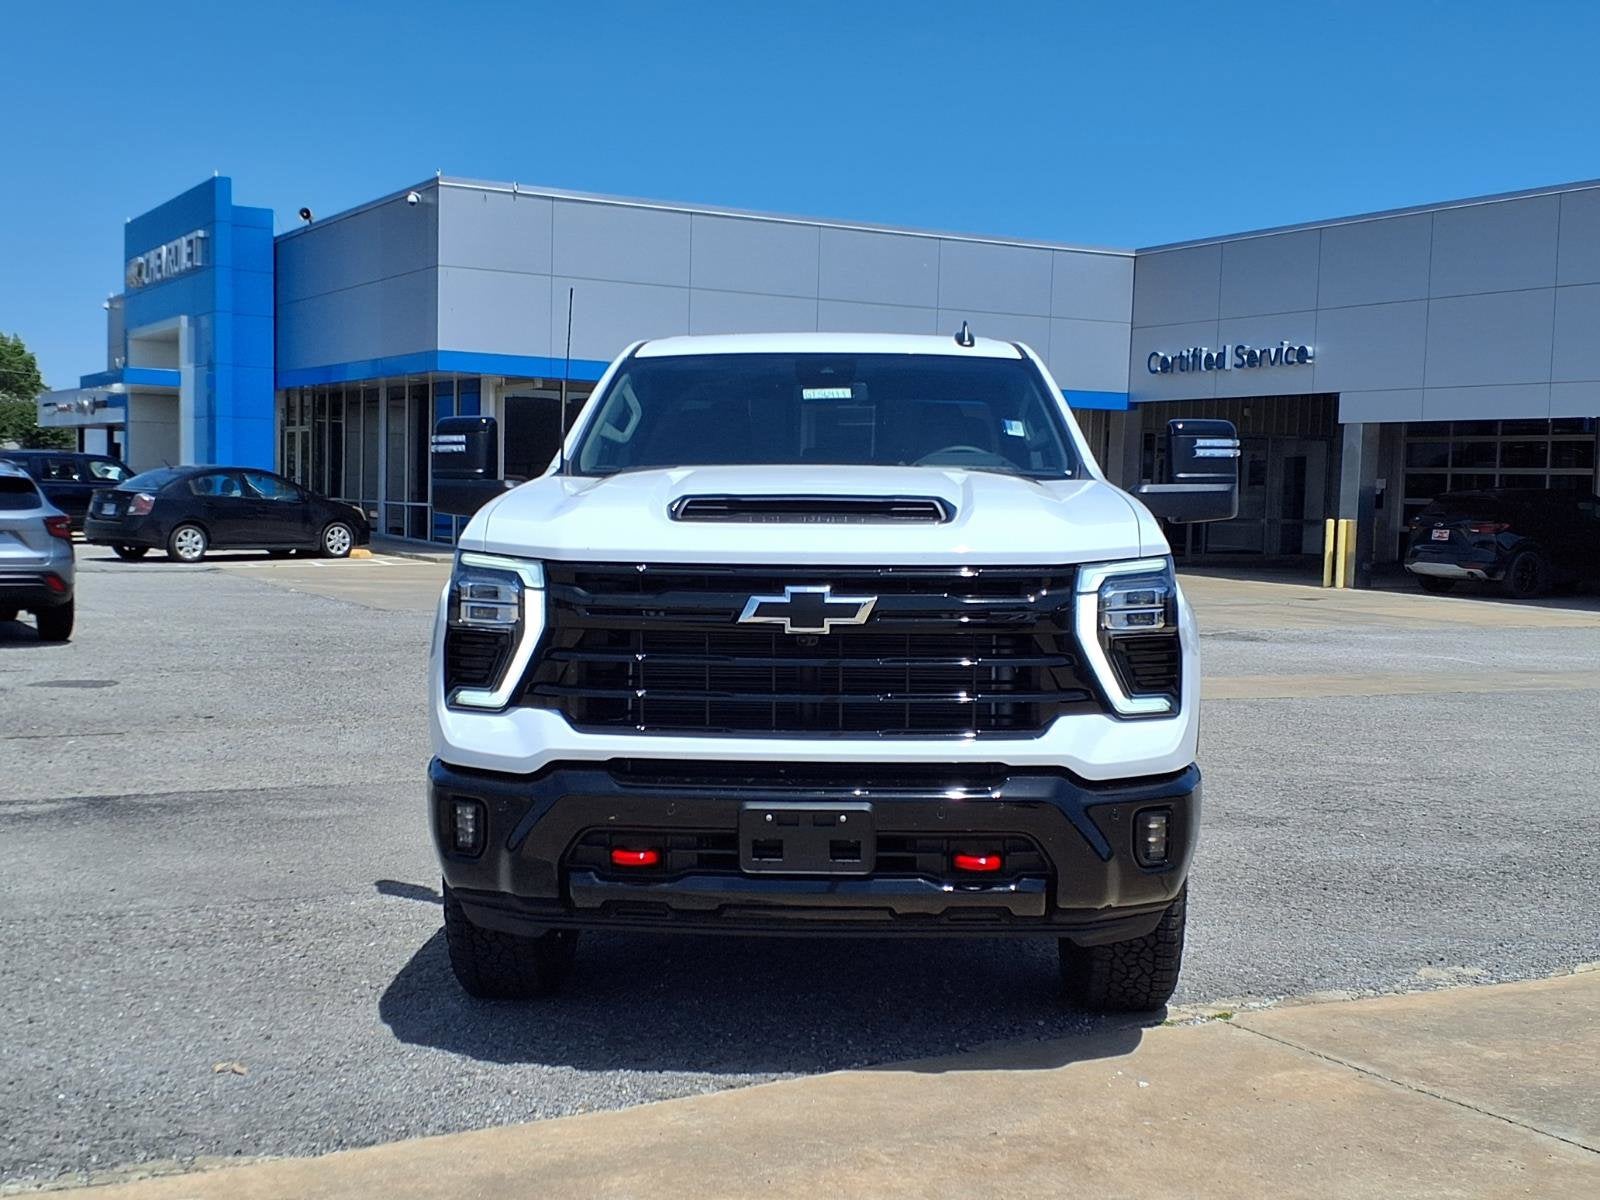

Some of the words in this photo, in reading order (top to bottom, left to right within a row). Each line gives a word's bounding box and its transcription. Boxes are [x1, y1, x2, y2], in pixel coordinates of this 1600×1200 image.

[143, 230, 208, 284] CHEVROLET
[1147, 344, 1230, 374] Certified
[1234, 341, 1314, 369] Service
